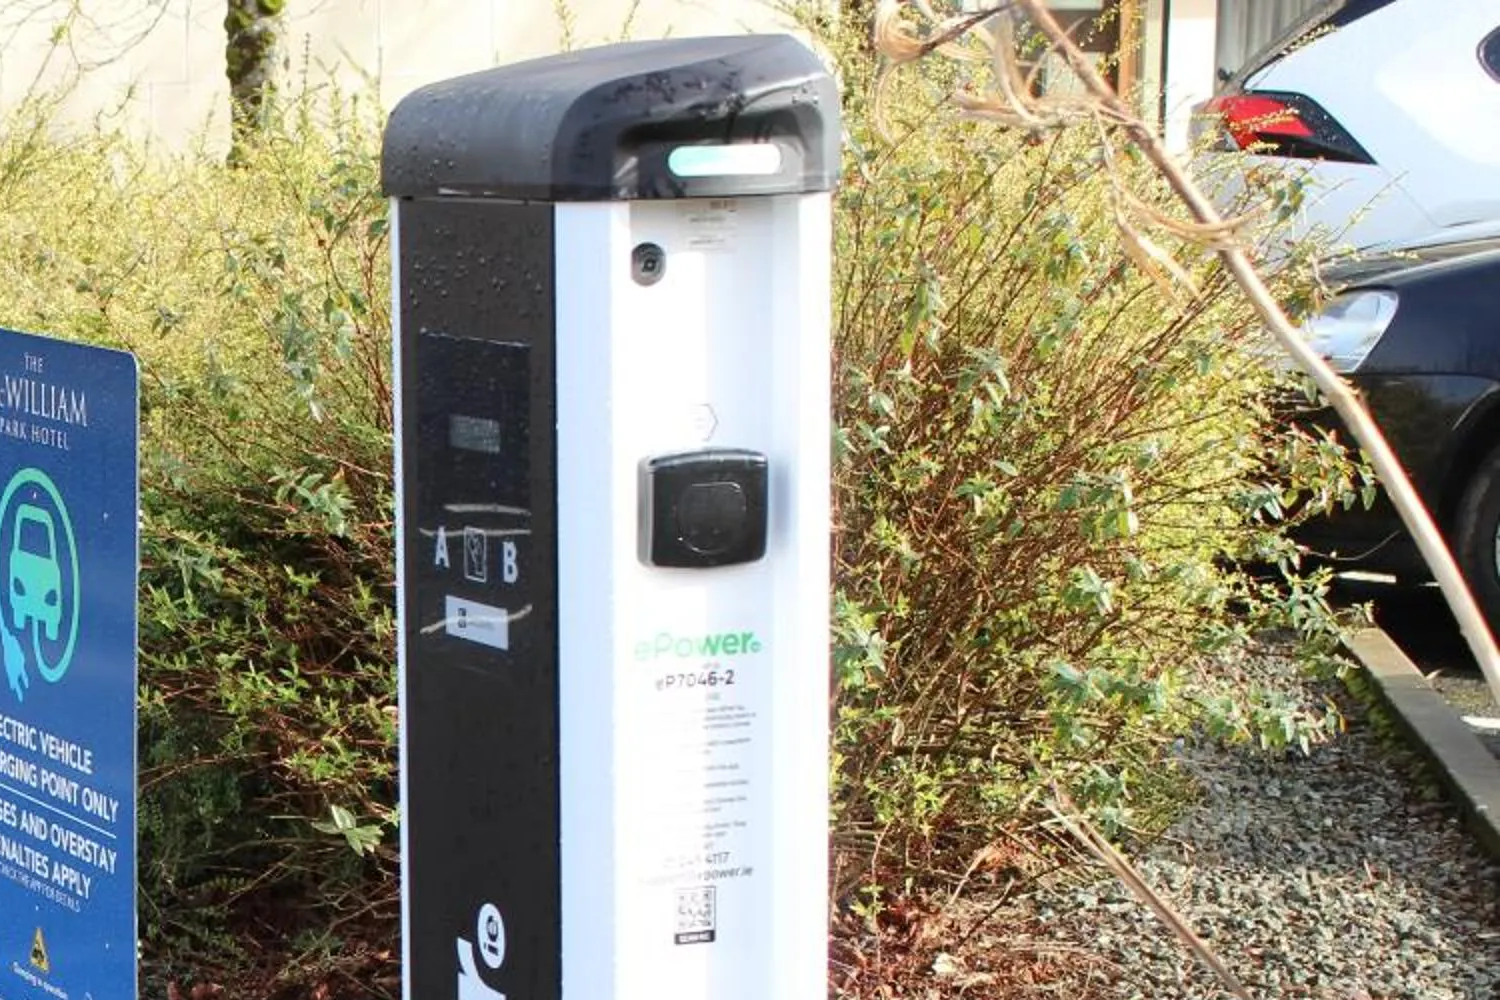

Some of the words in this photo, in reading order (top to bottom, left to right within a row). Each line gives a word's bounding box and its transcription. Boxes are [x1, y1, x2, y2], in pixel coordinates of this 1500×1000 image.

[24, 352, 44, 374] THE
[0, 416, 27, 440] PARK
[31, 424, 69, 451] HOTEL
[435, 526, 450, 569] A
[503, 541, 518, 584] B
[39, 731, 93, 775] VEHICLE
[41, 768, 79, 807] POINT
[81, 787, 119, 823] ONLY
[19, 809, 48, 841] AND
[51, 823, 118, 875] OVERSTAY
[51, 861, 92, 900] APPLY
